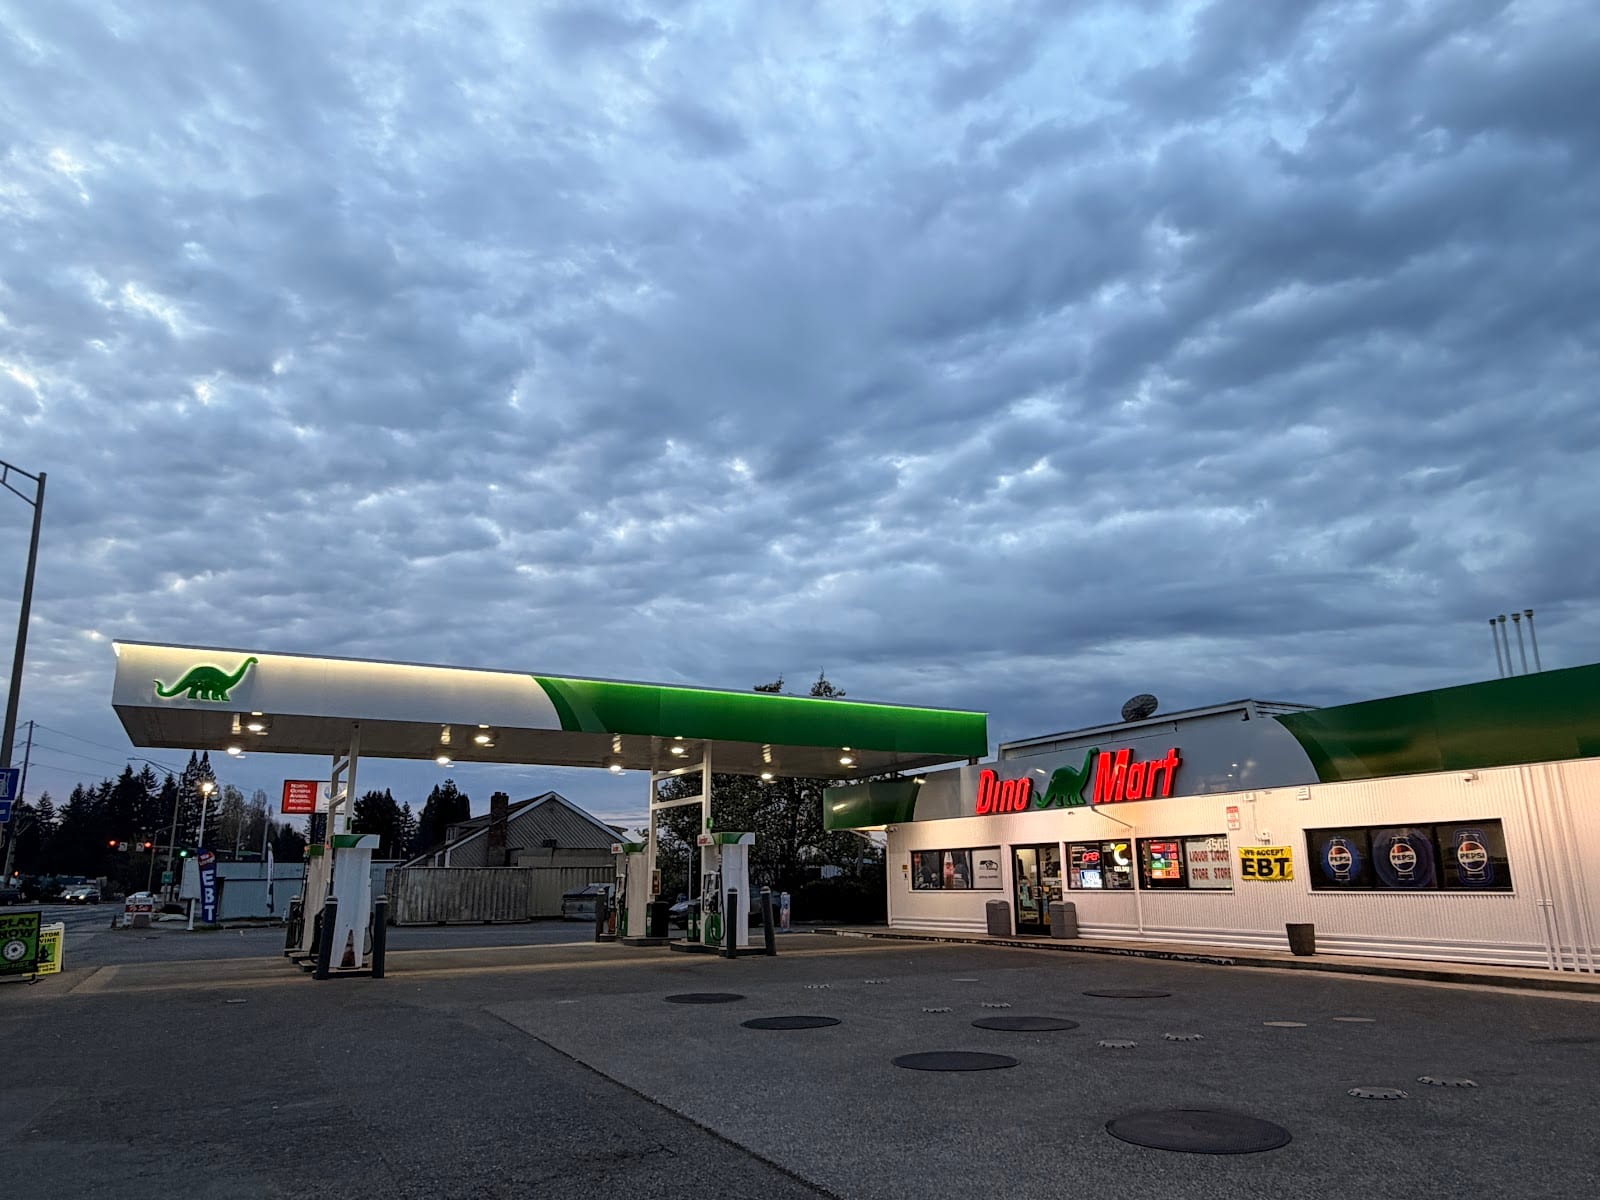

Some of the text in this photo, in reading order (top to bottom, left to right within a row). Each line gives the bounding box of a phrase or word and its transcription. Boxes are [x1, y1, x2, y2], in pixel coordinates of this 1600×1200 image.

[975, 747, 1183, 815] Dino Mart
[1205, 838, 1230, 851] 3505
[1082, 851, 1100, 863] OPEN
[1189, 850, 1208, 862] LIQUOR
[1256, 848, 1285, 856] ACCEPT
[1460, 852, 1485, 860] PEPSI
[1192, 867, 1231, 880] STORE STORE
[1241, 857, 1290, 877] EBT
[201, 870, 215, 921] EBT
